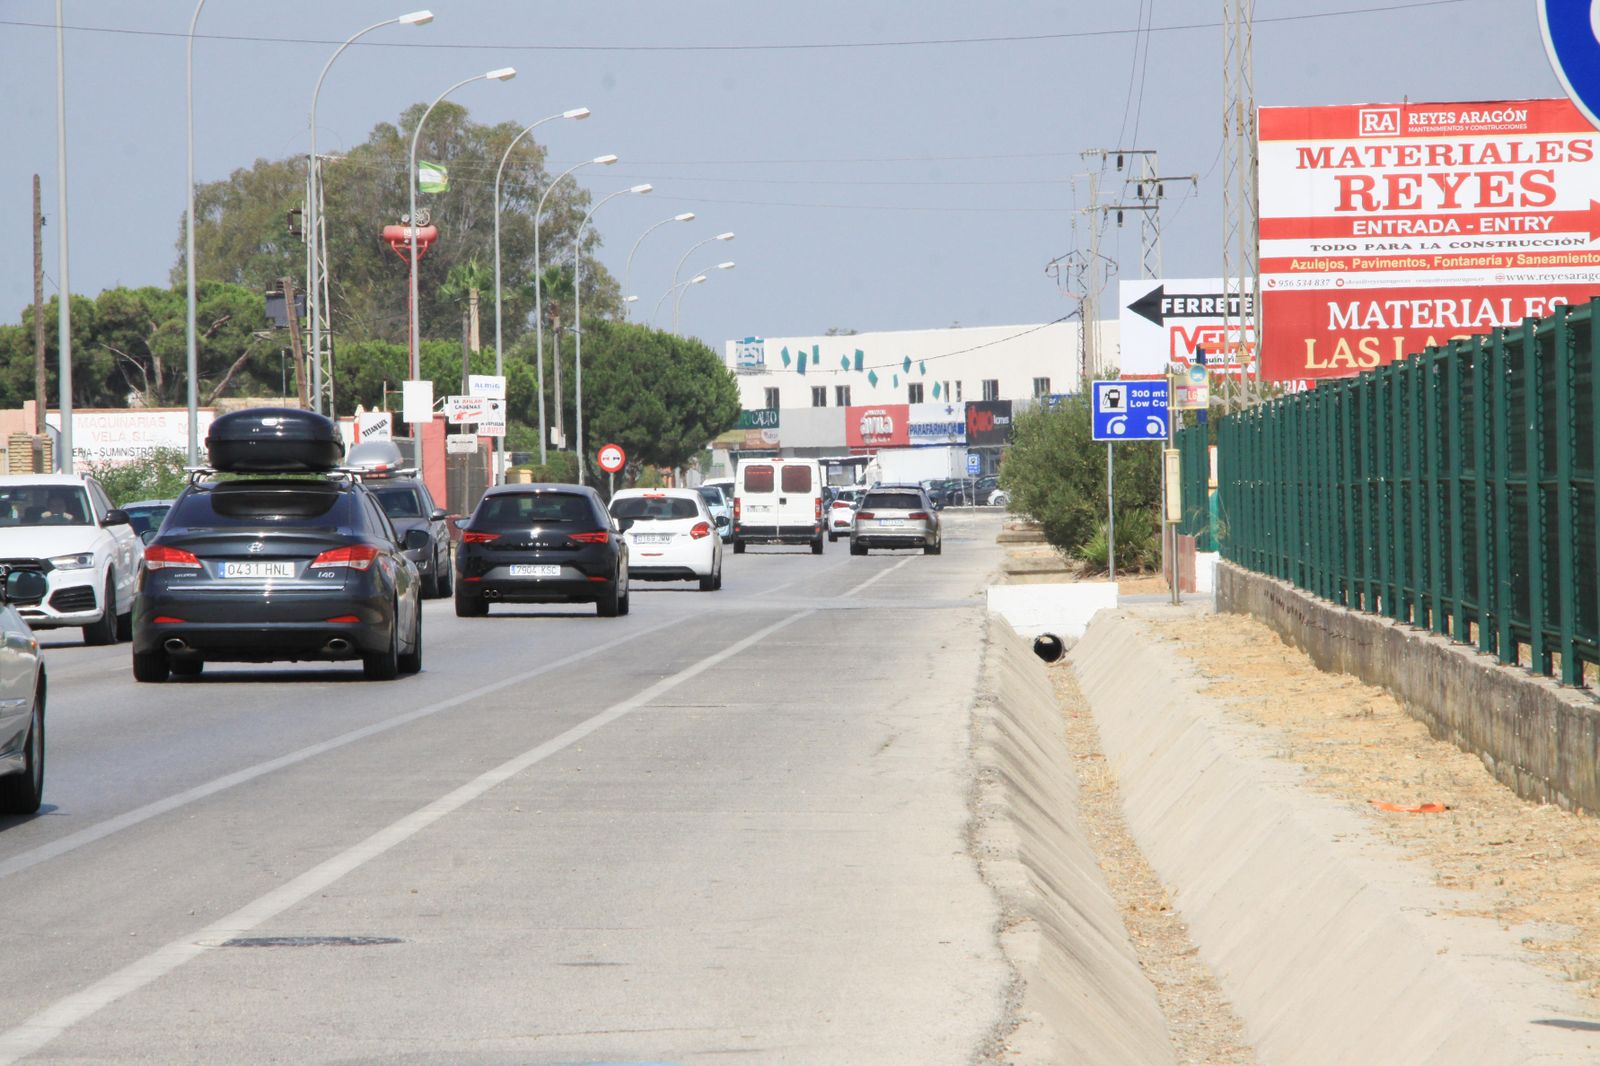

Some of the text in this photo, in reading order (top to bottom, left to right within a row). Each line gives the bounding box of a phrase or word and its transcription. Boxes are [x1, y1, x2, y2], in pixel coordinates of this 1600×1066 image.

[1364, 113, 1395, 131] RA
[1408, 107, 1527, 125] REYES ARAGÓN
[1470, 123, 1527, 131] CONSTRUCCIONES
[1296, 139, 1594, 169] MATERIALES
[1334, 169, 1557, 212] REYES
[1353, 218, 1461, 235] ENTRADA
[1479, 215, 1554, 232] ENTRY
[1310, 237, 1586, 252] TODO PARA LA CONSTRUCCIÓN
[1290, 258, 1348, 271] Azulejos,
[1352, 256, 1430, 270] Pavimentos,
[1434, 254, 1502, 267] Fontanería
[1506, 256, 1513, 267] y
[1296, 279, 1312, 287] 534
[1314, 278, 1331, 286] 837
[1304, 336, 1381, 369] LAS
[1131, 390, 1150, 398] 300
[1130, 400, 1150, 408] Low
[78, 416, 167, 429] MAQUINARIAS
[909, 422, 958, 436] PARAFARMACIA
[92, 431, 126, 442] VELA
[100, 446, 157, 458] SUMINISTRO
[228, 562, 289, 576] 0431 HNL
[516, 565, 537, 574] 7904
